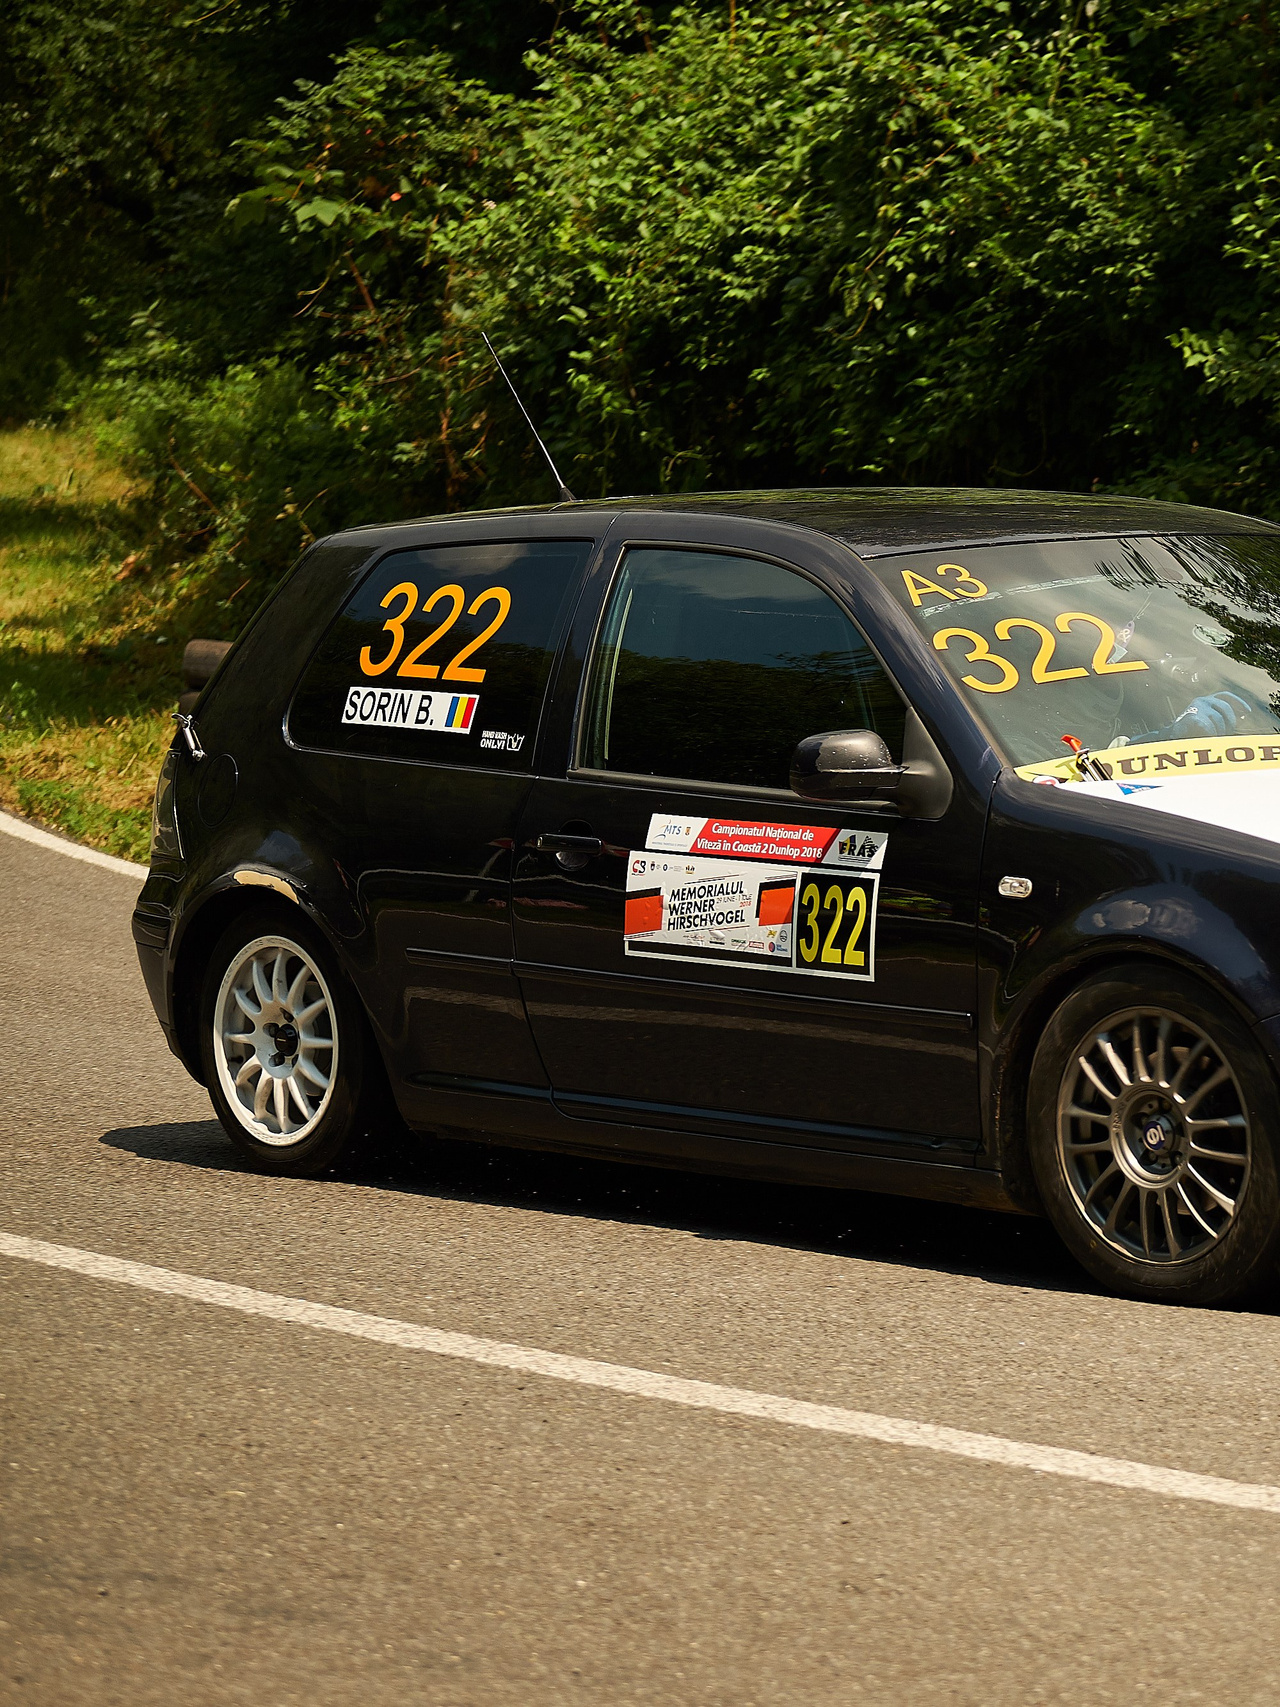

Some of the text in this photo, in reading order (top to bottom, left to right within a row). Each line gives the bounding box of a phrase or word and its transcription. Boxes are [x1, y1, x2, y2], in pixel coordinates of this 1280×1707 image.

[901, 563, 988, 607] A3
[359, 582, 512, 683] 322
[932, 611, 1150, 693] 322
[345, 690, 434, 726] SORIN B.
[480, 738, 505, 750] ONLY!
[663, 824, 682, 836] MTS
[711, 822, 814, 841] Campionatul Național de
[697, 838, 721, 850] Viteză
[722, 839, 732, 851] în
[732, 840, 761, 853] Coastă
[761, 843, 769, 854] 2
[768, 843, 800, 859] Dunlop
[800, 846, 823, 859] 2018
[669, 881, 744, 902] MEMORIALUL
[668, 898, 715, 916] WERNER
[667, 909, 745, 931] HIRSCHVOGEL
[799, 883, 867, 967] 322
